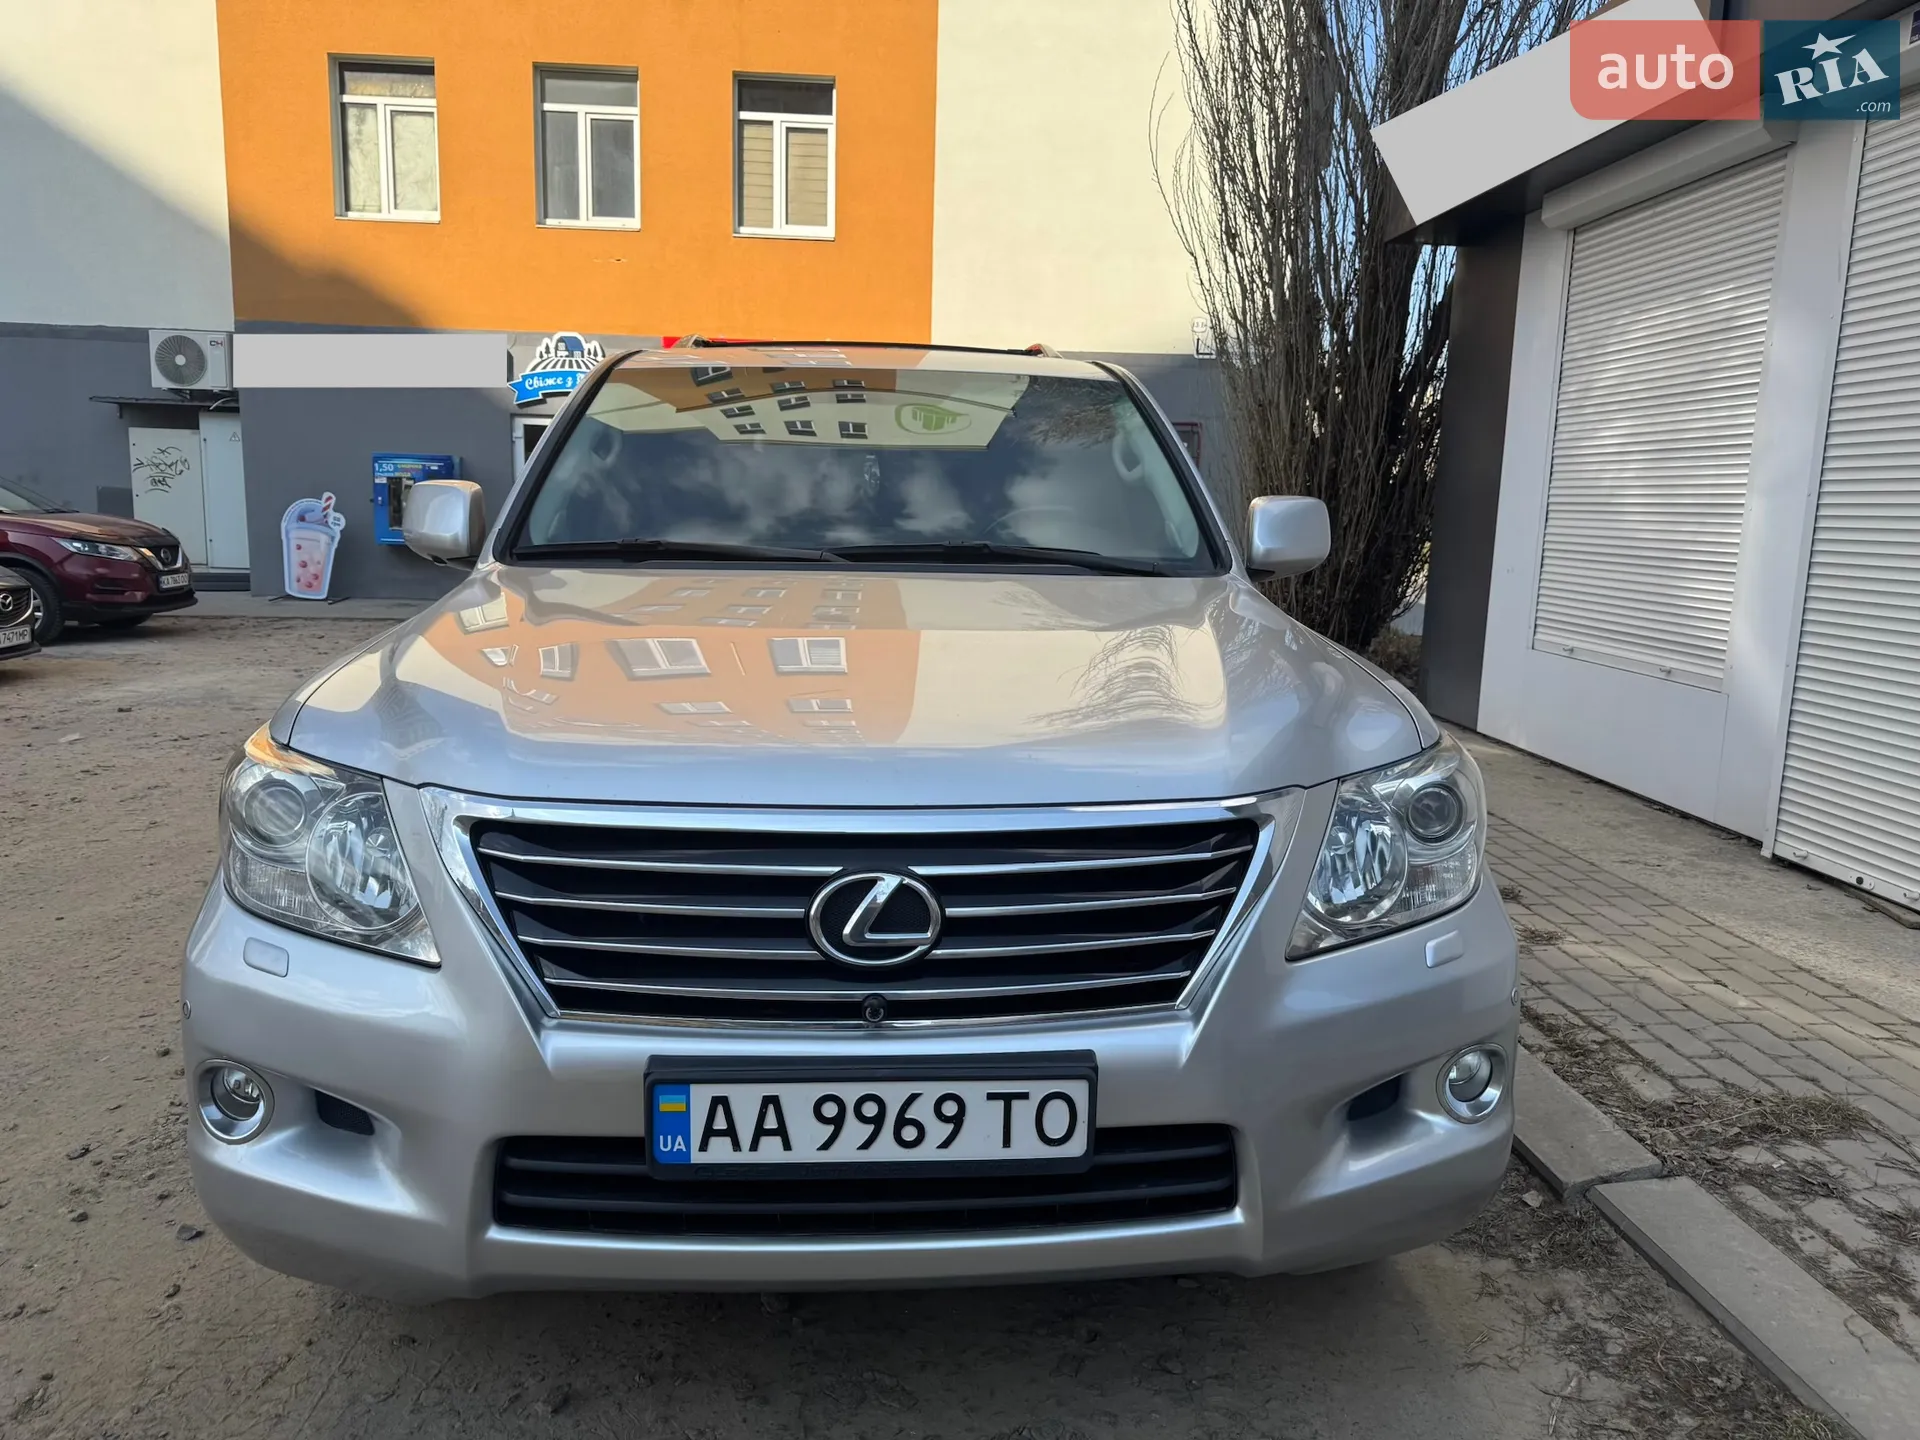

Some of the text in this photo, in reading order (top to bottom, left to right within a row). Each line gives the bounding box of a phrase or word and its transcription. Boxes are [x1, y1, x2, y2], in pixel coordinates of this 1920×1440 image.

[525, 376, 563, 390] Свіже
[565, 377, 574, 388] з
[374, 462, 394, 472] 1,50
[698, 1090, 1078, 1153] AA 9969 TO
[659, 1135, 687, 1153] UA
